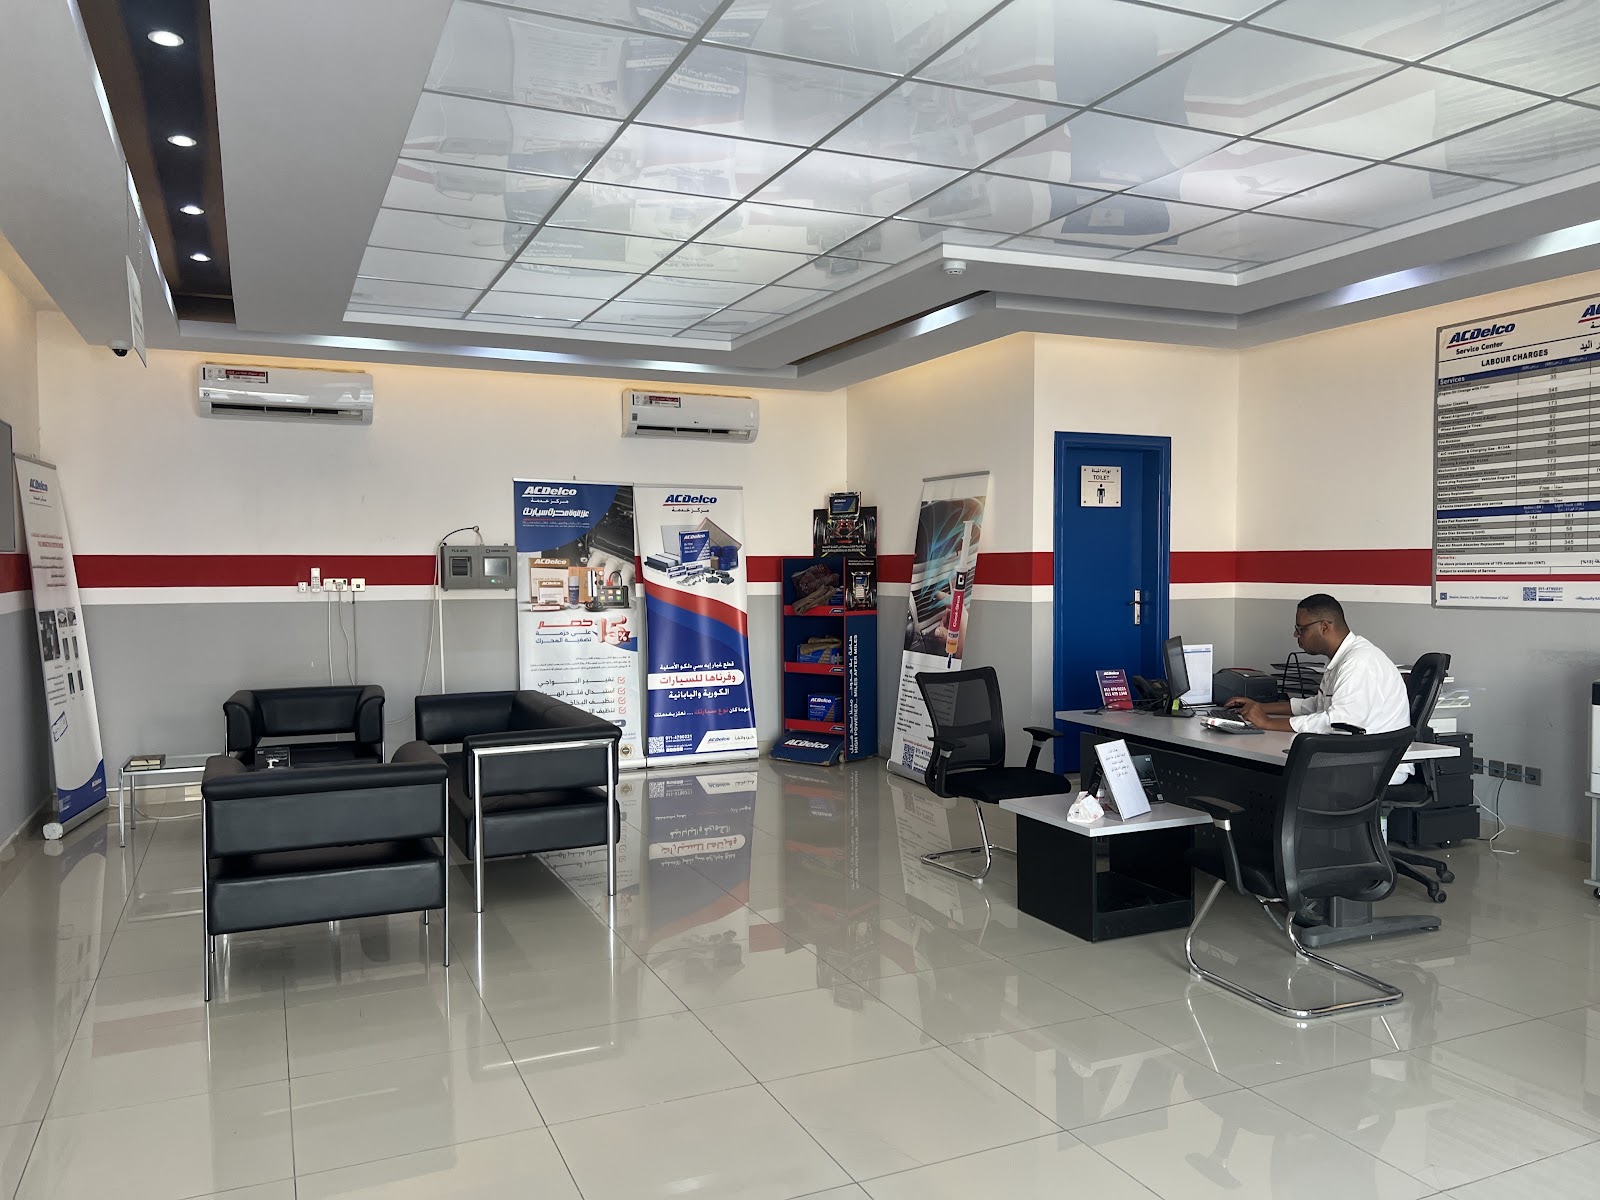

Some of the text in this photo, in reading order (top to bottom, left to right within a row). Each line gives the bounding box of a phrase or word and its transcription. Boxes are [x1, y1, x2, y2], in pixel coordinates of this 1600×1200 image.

[1449, 323, 1516, 344] ACDelco
[1456, 342, 1504, 355] Service Center
[1481, 356, 1511, 366] LABOUR
[1512, 349, 1548, 361] CHARGES
[1440, 376, 1465, 385] Services
[29, 478, 48, 491] ACDelco
[524, 486, 577, 495] ACDelco
[665, 494, 717, 504] ACDelco
[538, 619, 593, 629] خصم
[660, 662, 679, 671] الأصلية
[660, 672, 736, 686] وفرناها للسيارات
[668, 688, 729, 700] الكورية واليابانية
[784, 739, 829, 749] ACDelco
